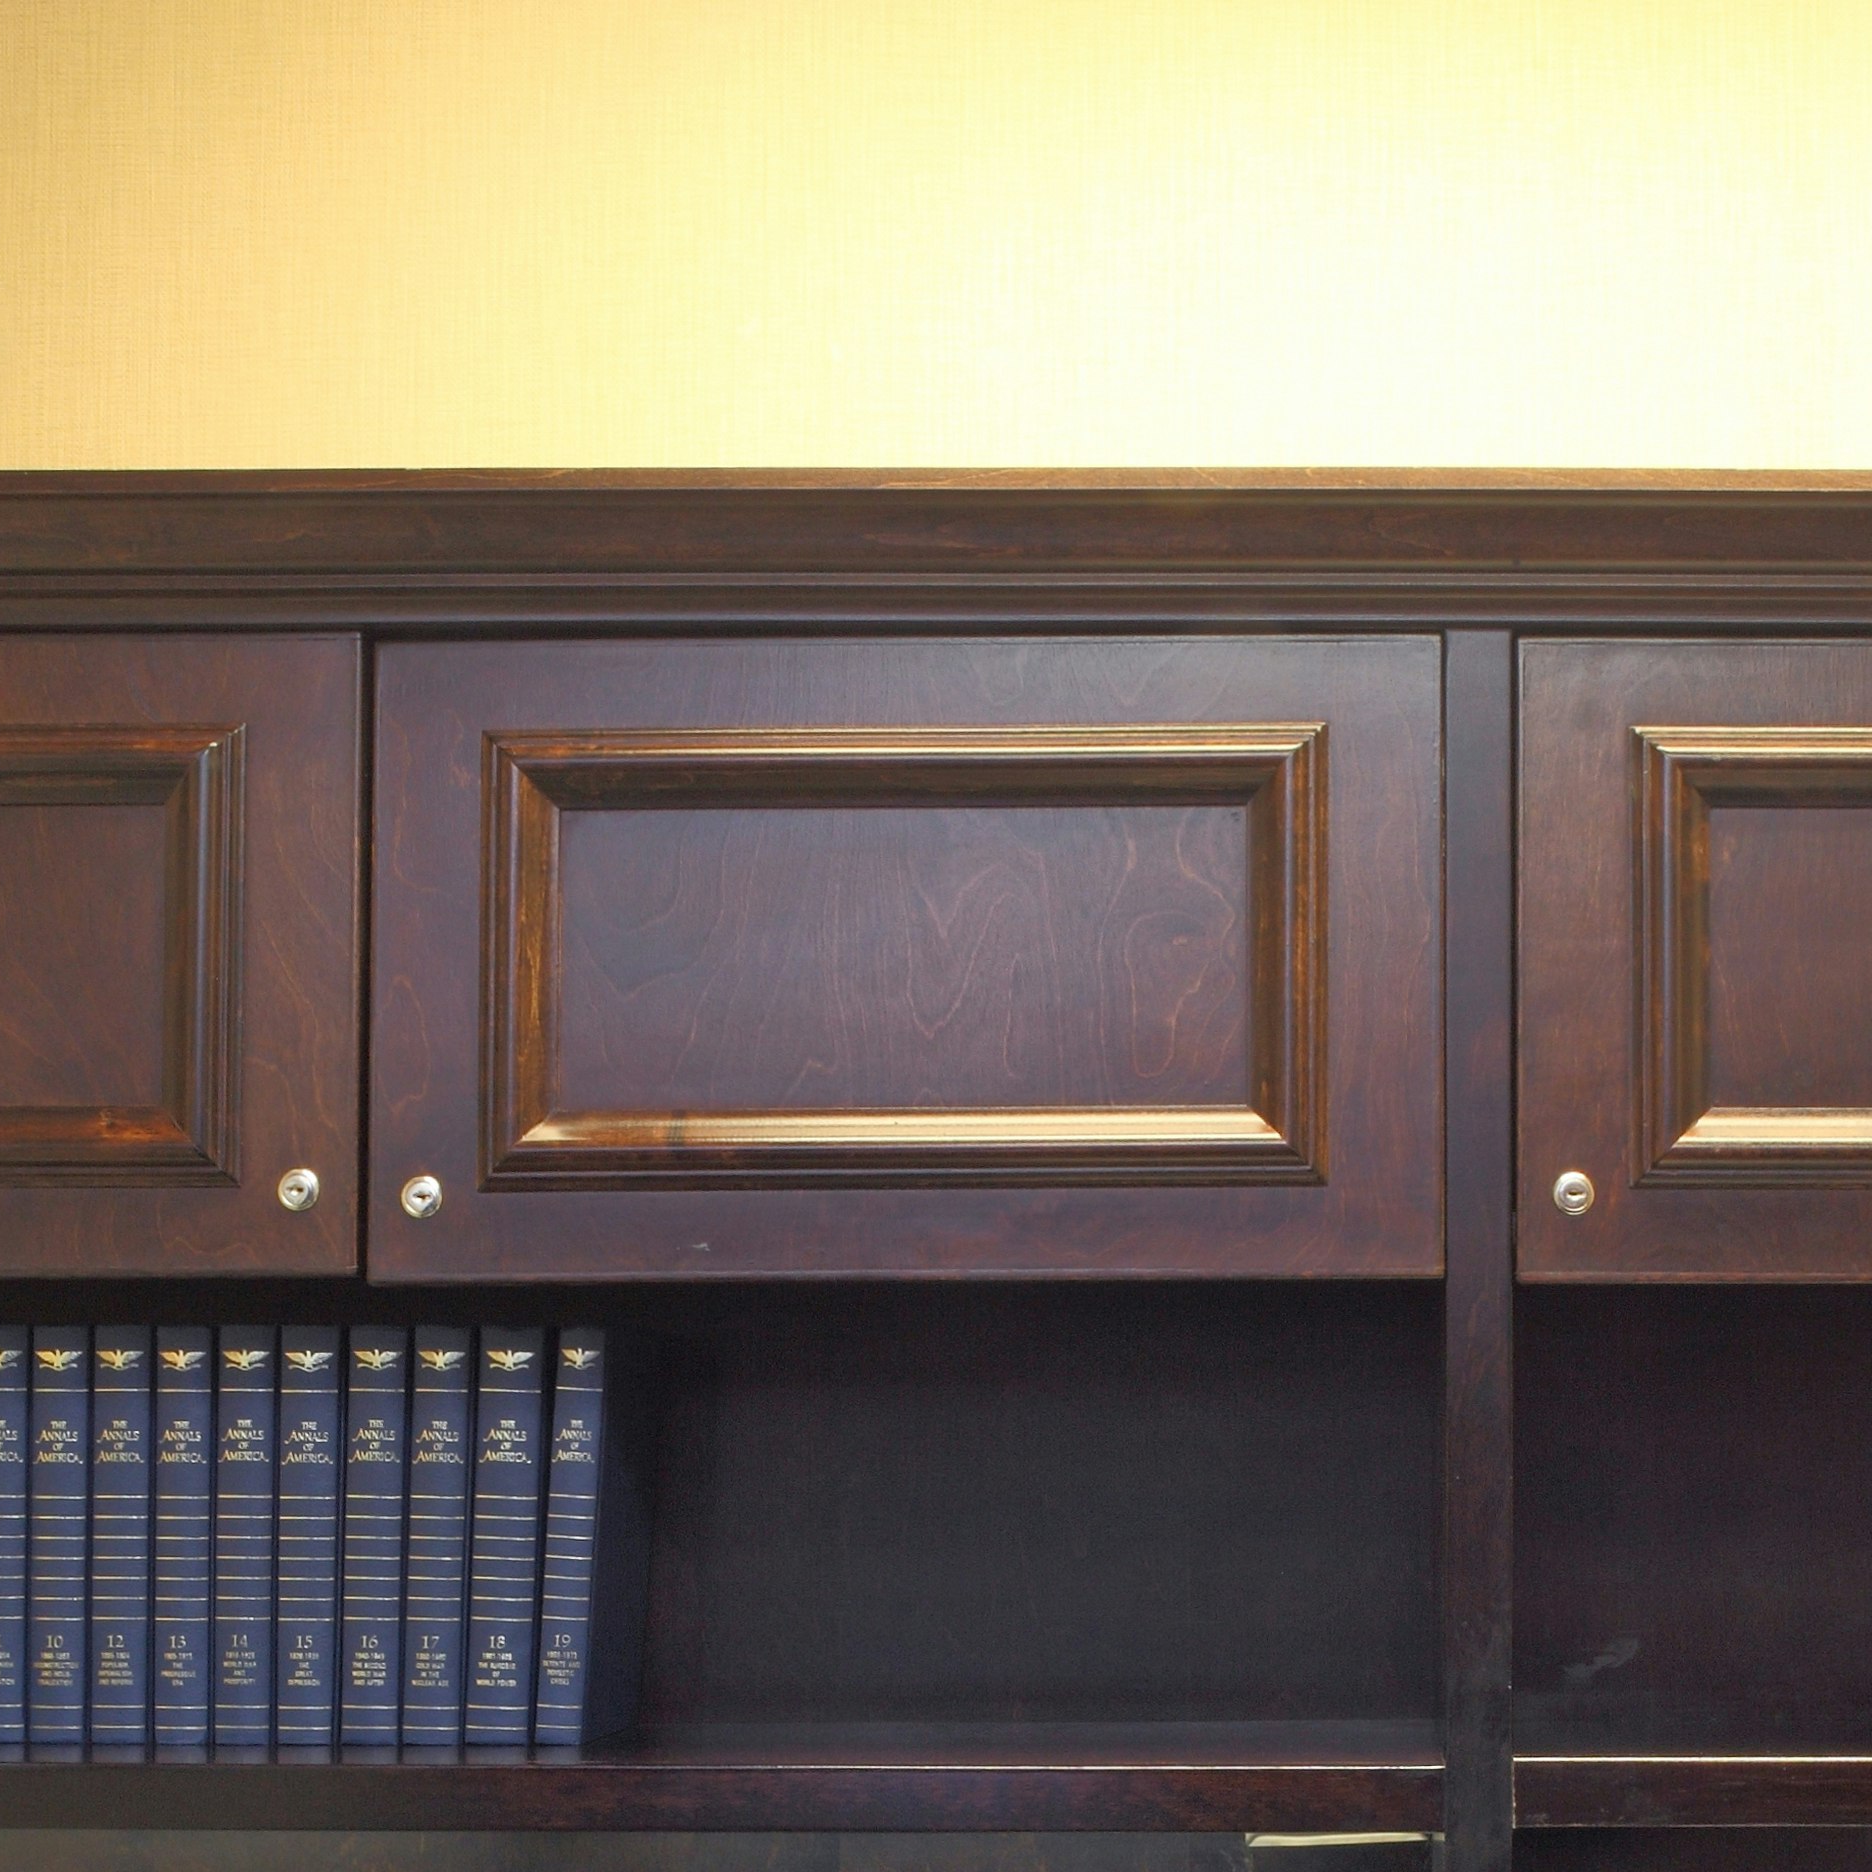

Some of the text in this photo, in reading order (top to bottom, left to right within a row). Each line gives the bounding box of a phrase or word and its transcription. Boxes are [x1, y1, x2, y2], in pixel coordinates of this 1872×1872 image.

[51, 1421, 66, 1429] THE
[112, 1421, 127, 1429] THE
[173, 1421, 190, 1429] THE
[237, 1420, 252, 1428] THE
[302, 1422, 317, 1430] THE
[368, 1420, 384, 1428] THE
[432, 1421, 448, 1429] THE
[500, 1420, 516, 1428] THE
[571, 1420, 584, 1428] THE
[36, 1431, 78, 1443] ANNALS
[97, 1431, 140, 1443] ANNALS
[159, 1431, 201, 1443] ANNALS
[222, 1430, 264, 1441] ANNALS
[285, 1431, 328, 1444] ANNALS
[352, 1430, 395, 1442] ANNALS
[416, 1431, 459, 1443] ANNALS
[483, 1430, 527, 1442] ANNALS
[556, 1430, 592, 1441] ANNALS
[53, 1443, 64, 1451] OF
[176, 1443, 187, 1451] OF
[433, 1443, 444, 1451] OF
[501, 1442, 511, 1450] OF
[570, 1442, 579, 1450] OF
[33, 1452, 83, 1464] AMERICA
[94, 1452, 144, 1464] AMERICA
[157, 1452, 207, 1464] AMERICA
[218, 1451, 269, 1463] AMERICA
[282, 1453, 333, 1465] AMERICA
[349, 1451, 400, 1463] AMERICA
[413, 1452, 464, 1464] AMERICA
[480, 1451, 531, 1464] AMERICA
[552, 1451, 595, 1463] AMERICA
[46, 1635, 63, 1648] 10
[107, 1635, 124, 1648] 12
[169, 1636, 186, 1648] 13
[232, 1635, 248, 1648] 14
[296, 1636, 312, 1648] 15
[361, 1636, 378, 1648] 16
[422, 1636, 439, 1648] 17
[490, 1636, 505, 1648] 18
[554, 1635, 571, 1648] 19
